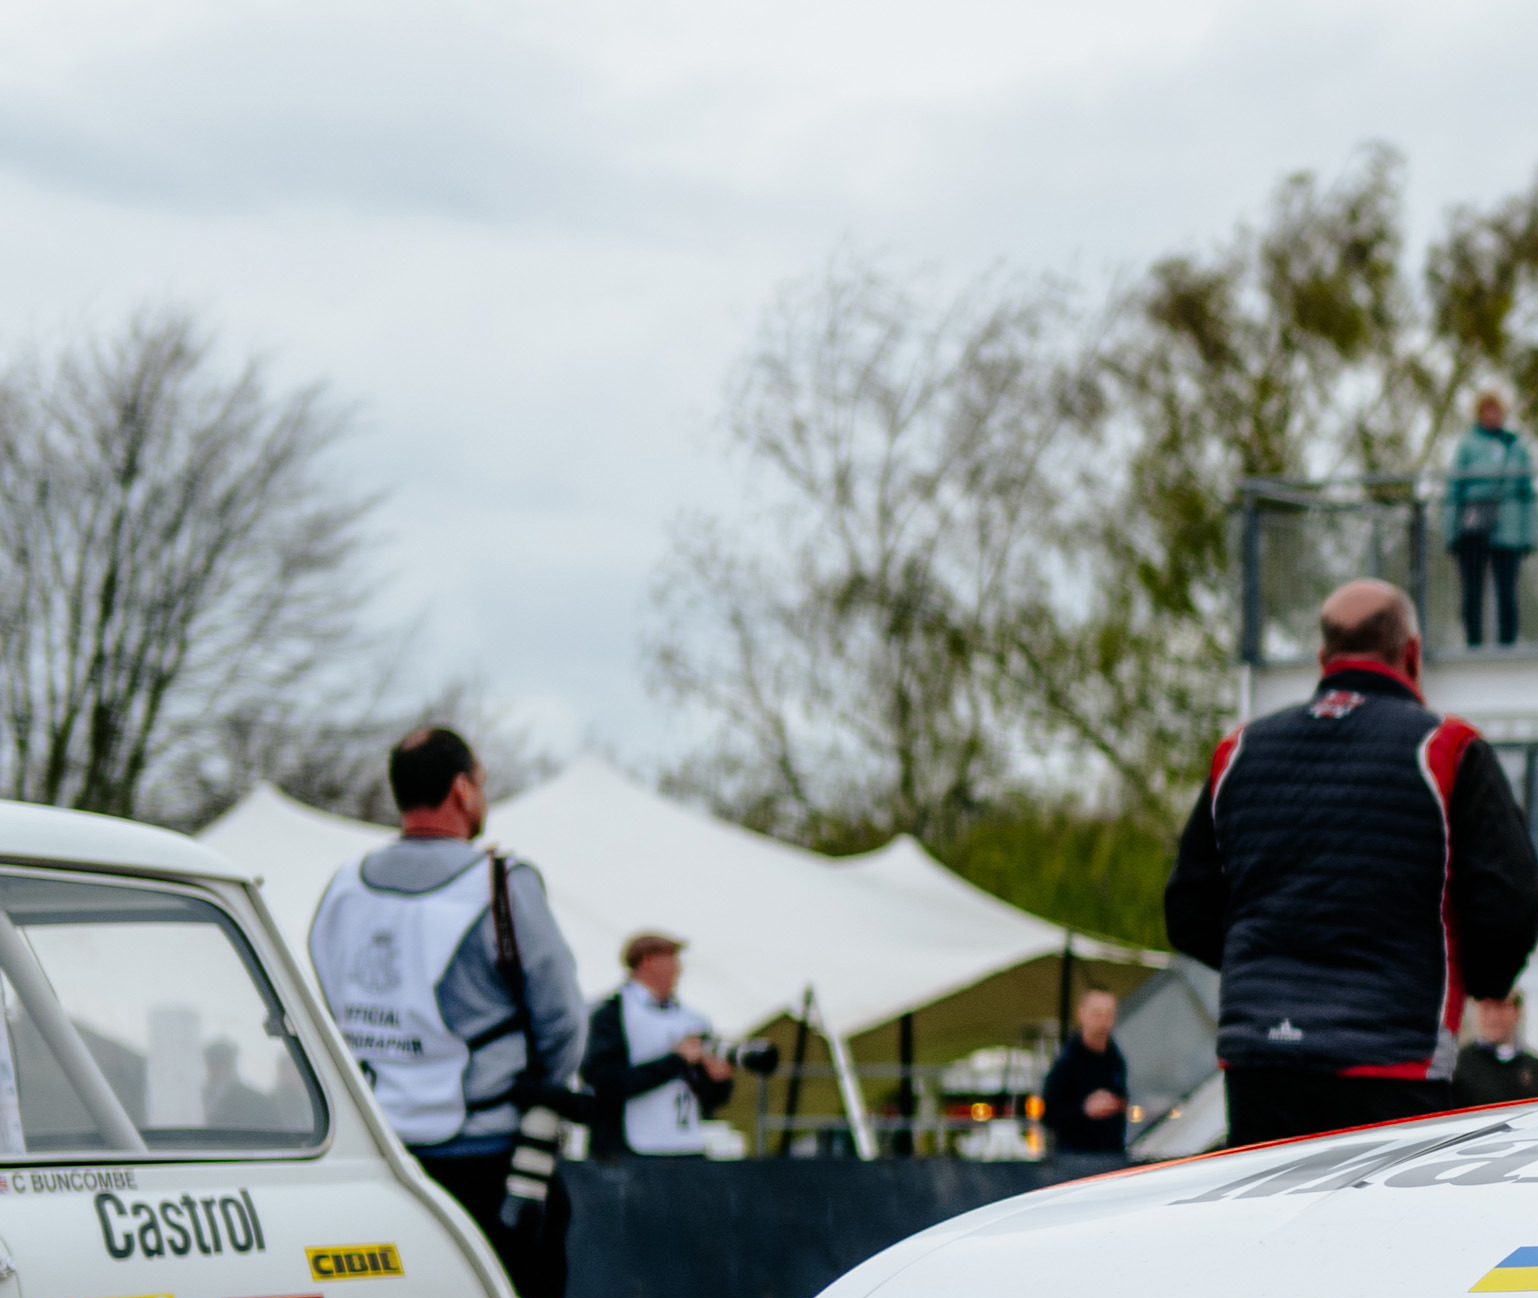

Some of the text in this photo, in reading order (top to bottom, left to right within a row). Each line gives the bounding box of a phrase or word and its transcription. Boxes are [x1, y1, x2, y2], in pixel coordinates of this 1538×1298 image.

[12, 1169, 137, 1193] C BUNCOMBE
[94, 1188, 266, 1260] Castrol
